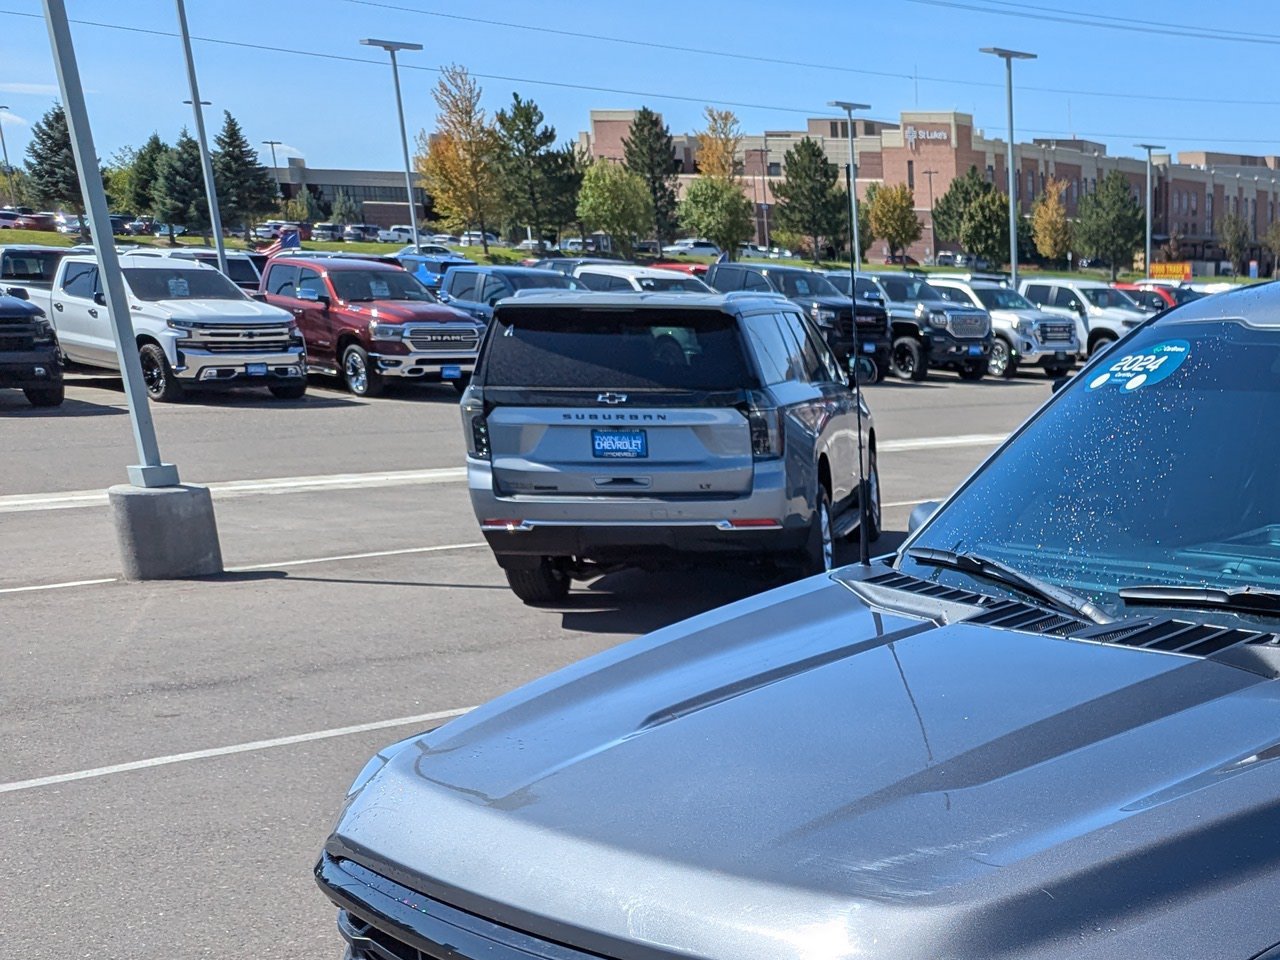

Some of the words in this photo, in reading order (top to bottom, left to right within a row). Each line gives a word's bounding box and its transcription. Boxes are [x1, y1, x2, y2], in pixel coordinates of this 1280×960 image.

[1109, 354, 1168, 372] 2024
[562, 413, 668, 421] SUBURBAN
[595, 440, 642, 450] CHEVROLET
